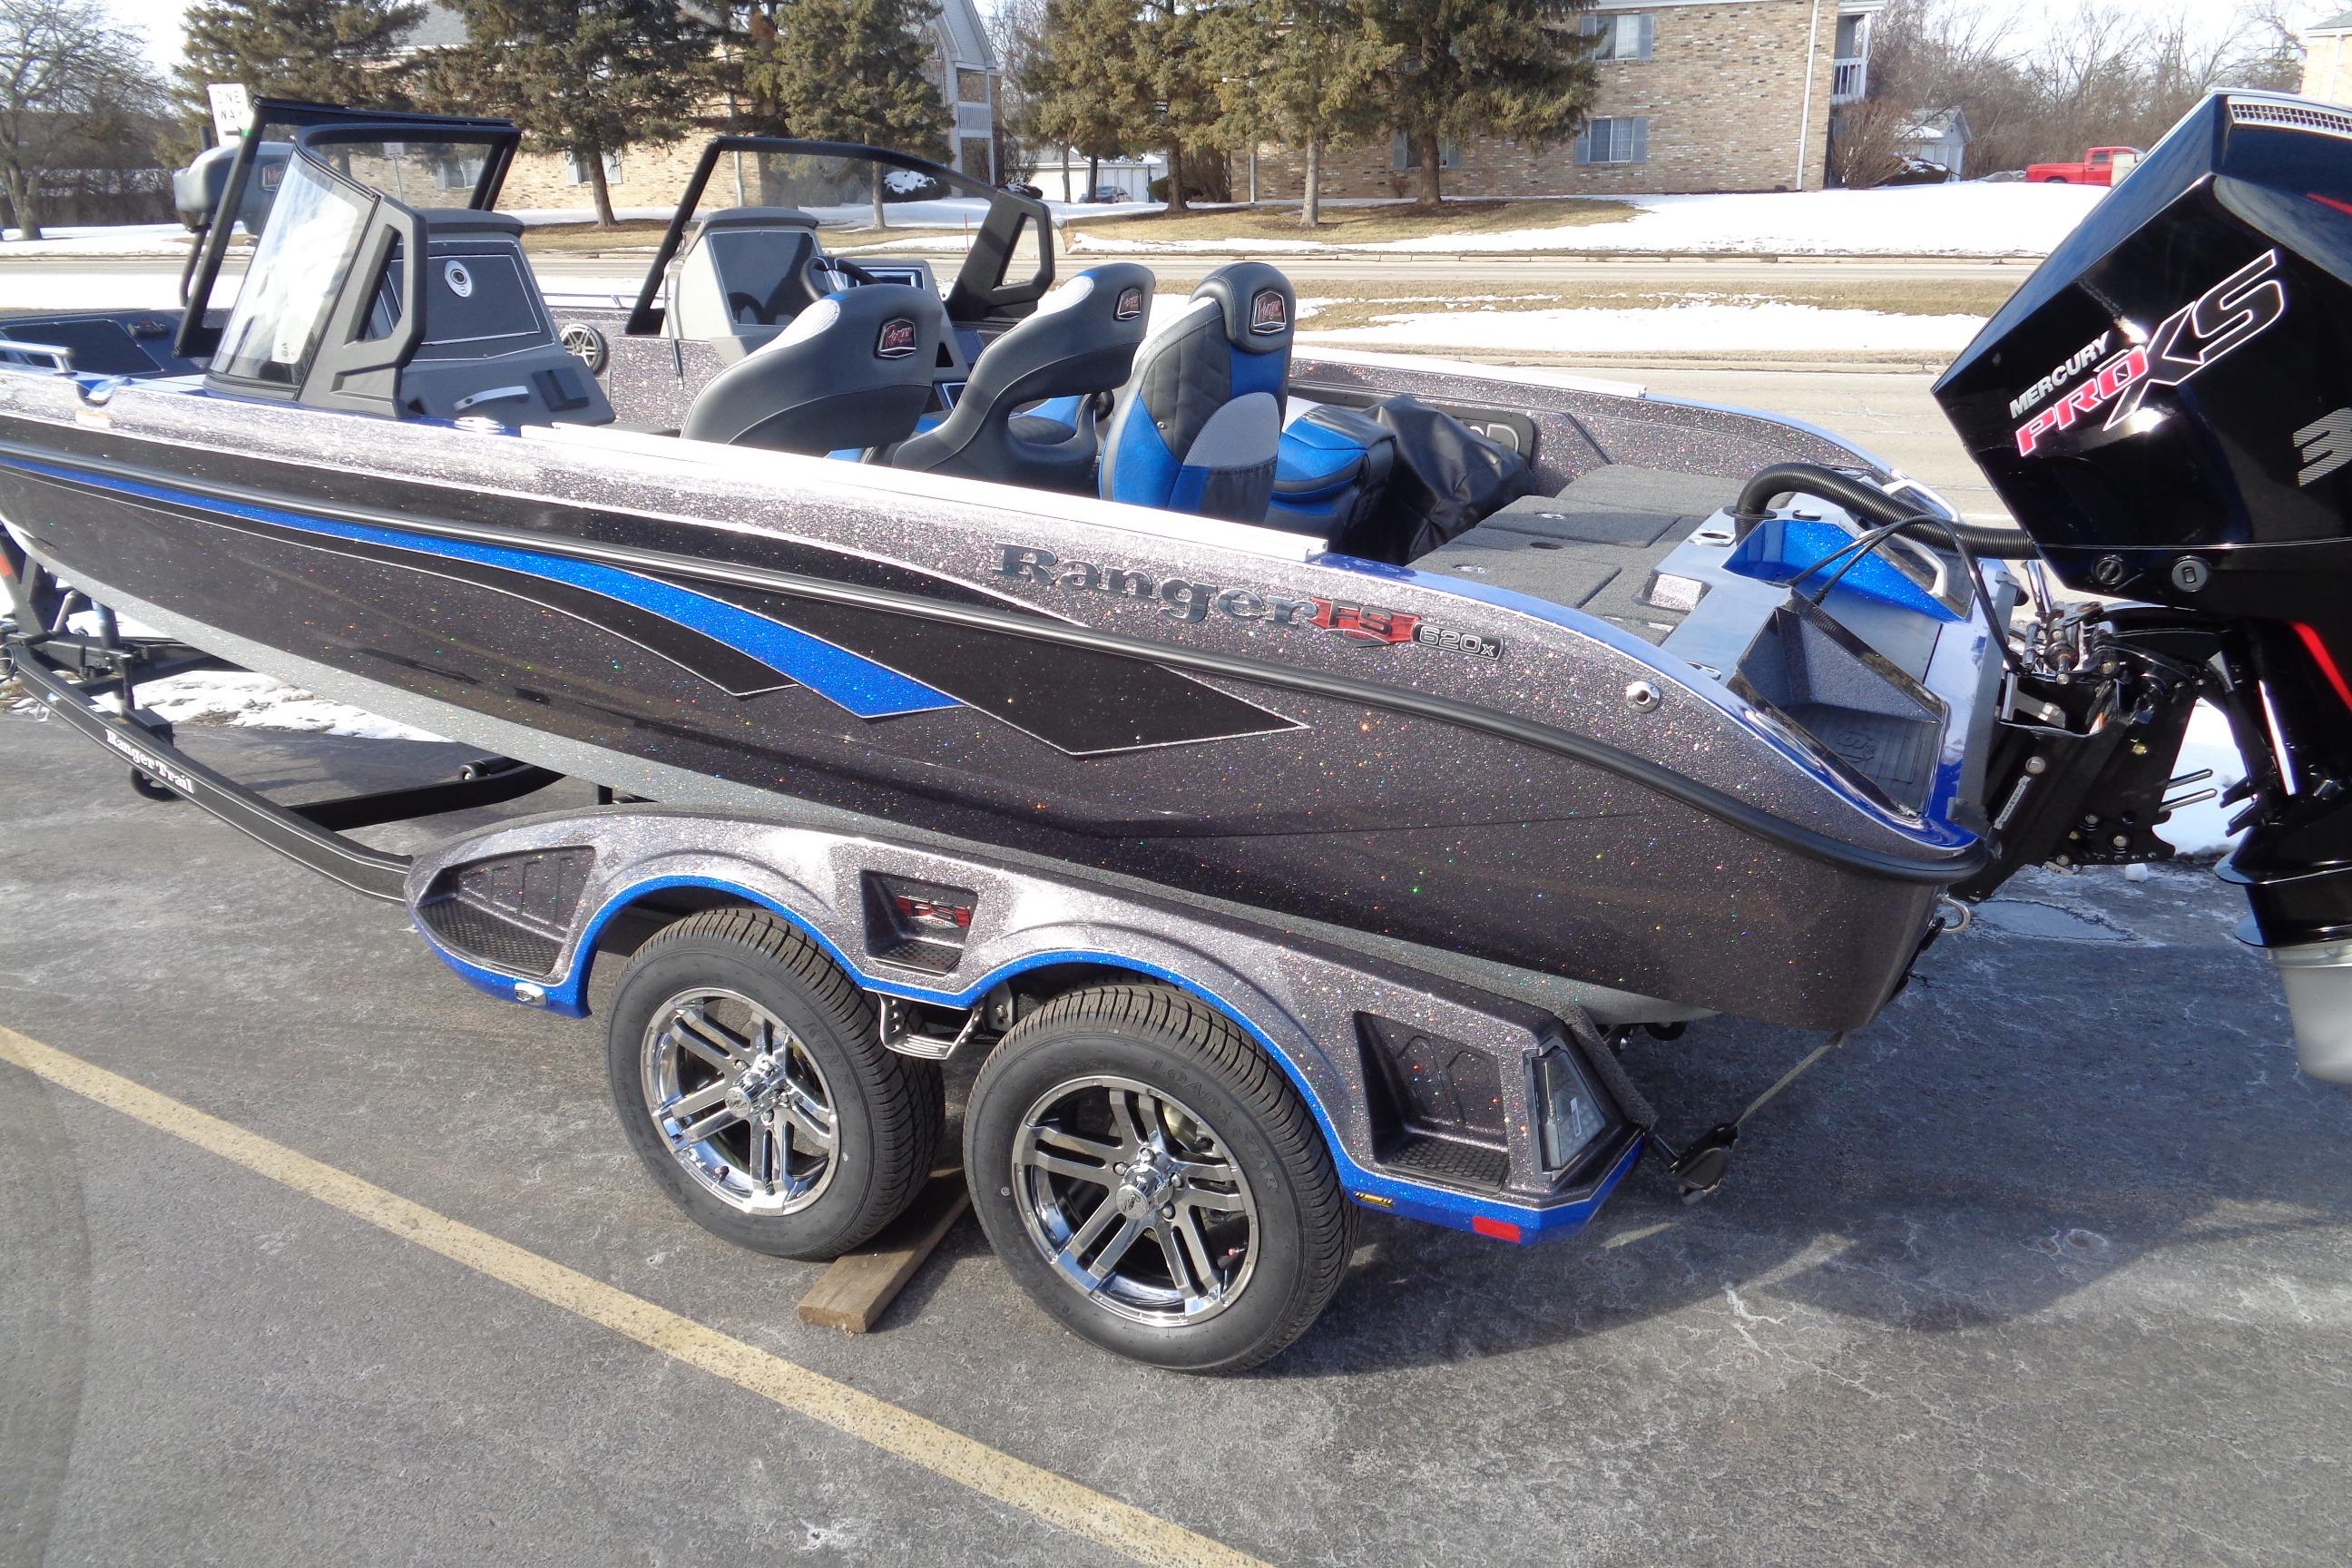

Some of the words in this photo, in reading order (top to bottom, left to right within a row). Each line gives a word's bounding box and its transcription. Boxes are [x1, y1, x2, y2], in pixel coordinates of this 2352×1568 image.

[217, 90, 241, 103] ONE
[220, 109, 245, 121] WAY
[2009, 330, 2112, 419] MERCURY
[2015, 345, 2150, 457] PRO
[2102, 248, 2285, 432] XS
[994, 543, 1318, 629] Ranger
[1328, 598, 1393, 636] FS
[104, 729, 155, 769] Ranger
[154, 760, 195, 794] Trail
